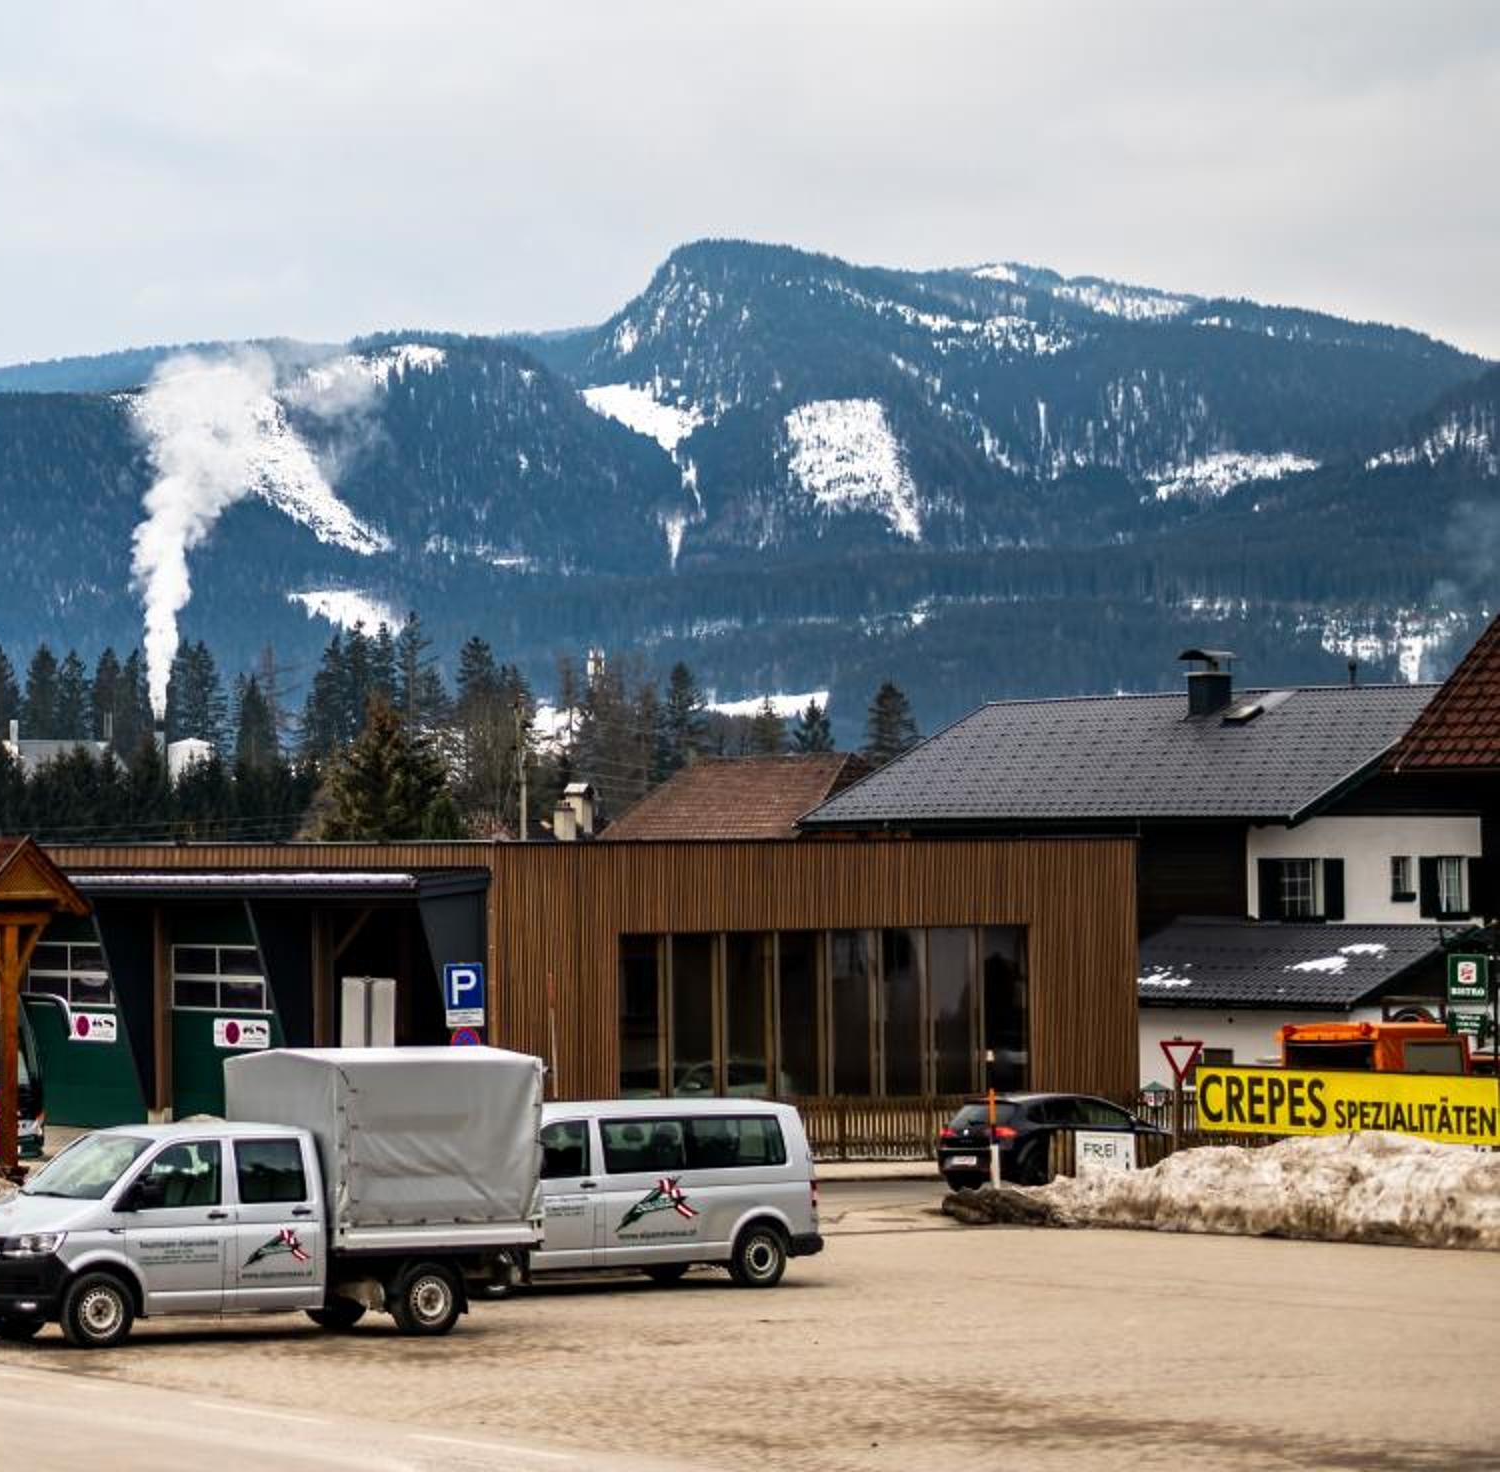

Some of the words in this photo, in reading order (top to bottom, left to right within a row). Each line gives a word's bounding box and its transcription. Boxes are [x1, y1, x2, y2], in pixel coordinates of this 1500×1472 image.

[451, 969, 477, 1006] P
[1451, 986, 1486, 996] BISTRO
[1200, 1073, 1327, 1128] CREPES
[1333, 1097, 1497, 1137] SPEZIALITÄTEN
